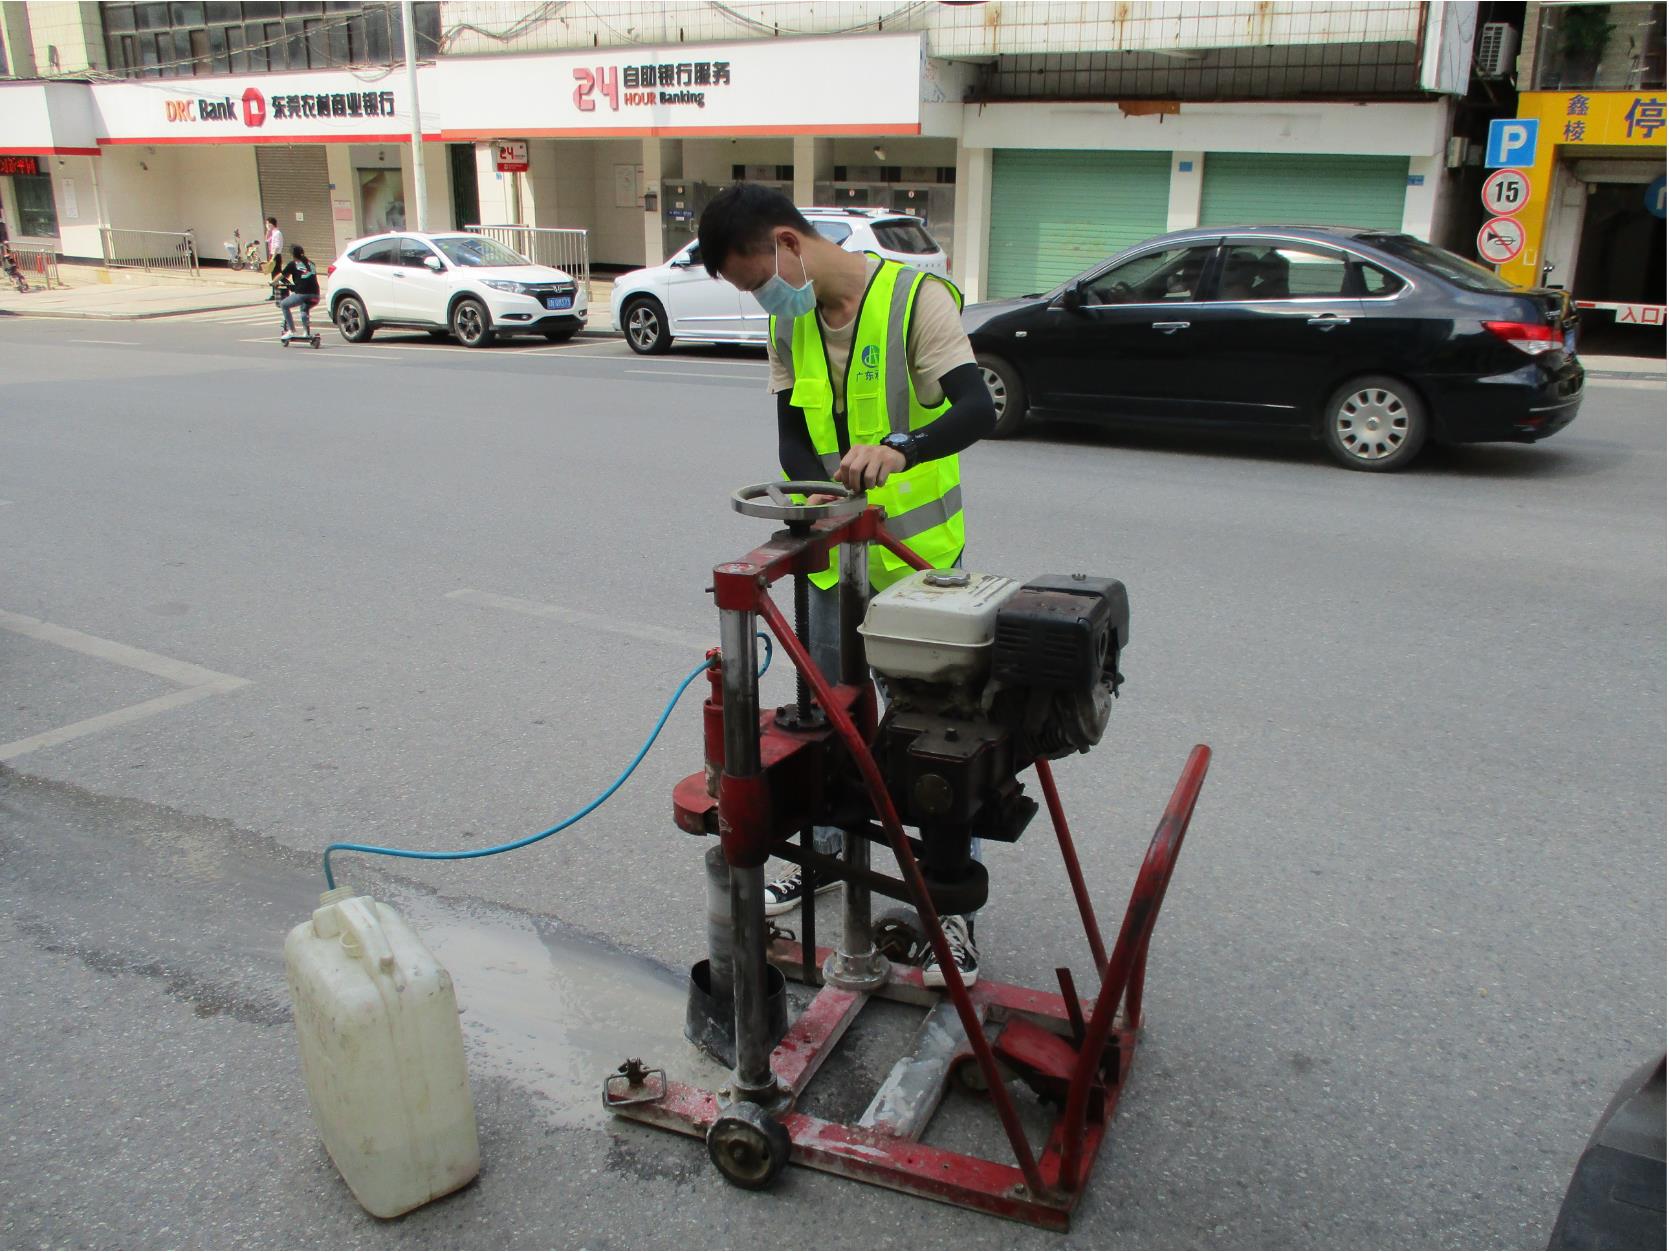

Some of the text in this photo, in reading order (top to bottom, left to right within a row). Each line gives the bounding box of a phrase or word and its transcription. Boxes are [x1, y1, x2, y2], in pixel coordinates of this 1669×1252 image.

[572, 65, 619, 112] 24
[623, 61, 731, 89] 自助银行服务
[165, 96, 238, 122] DRC Bank
[271, 90, 395, 120] 东莞农村商业银行
[624, 90, 705, 108] HOUR Banking
[1624, 97, 1668, 139] 停
[1499, 125, 1528, 163] P
[1495, 180, 1520, 204] 15
[1621, 306, 1660, 324] 入口
